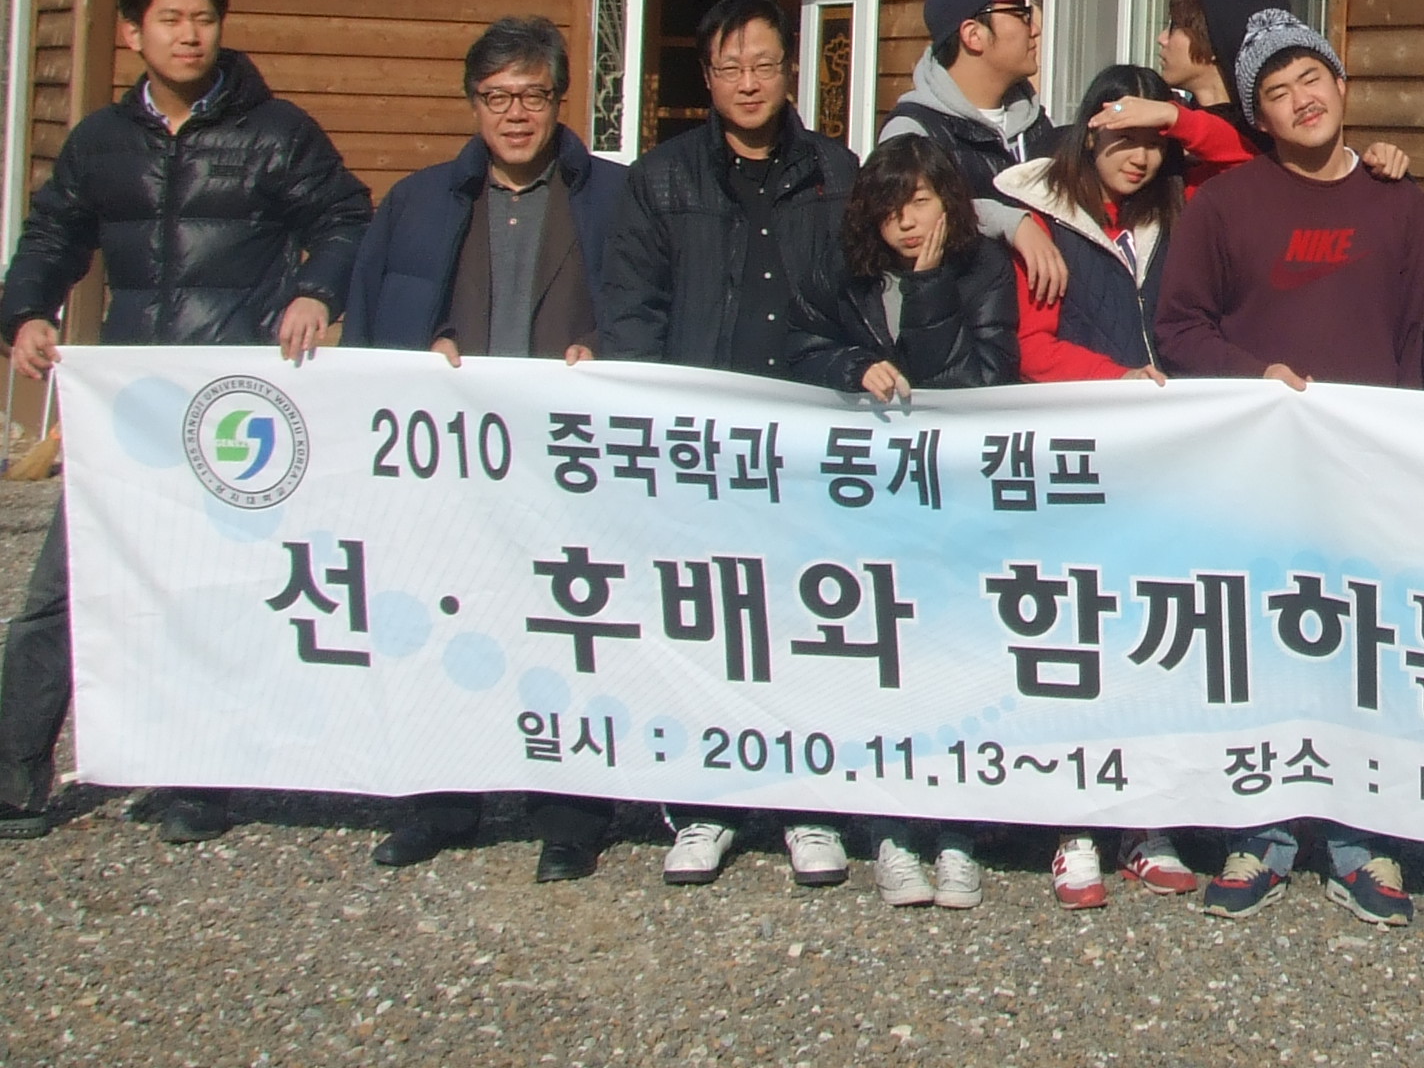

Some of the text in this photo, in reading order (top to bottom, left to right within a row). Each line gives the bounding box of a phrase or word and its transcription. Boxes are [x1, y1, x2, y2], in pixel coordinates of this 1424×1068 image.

[1286, 228, 1356, 263] NIKE
[187, 403, 204, 443] SANGJI
[204, 379, 273, 400] UNIVERSITY
[275, 395, 302, 434] WONJU
[290, 441, 305, 479] KOREA
[372, 408, 1106, 512] 2010 중국학과 동계 캠프
[265, 540, 371, 668] 선
[525, 546, 915, 689] 후배와
[517, 711, 617, 768] 일시
[703, 727, 1129, 792] 2010.11.13~14
[1223, 737, 1335, 797] 장소
